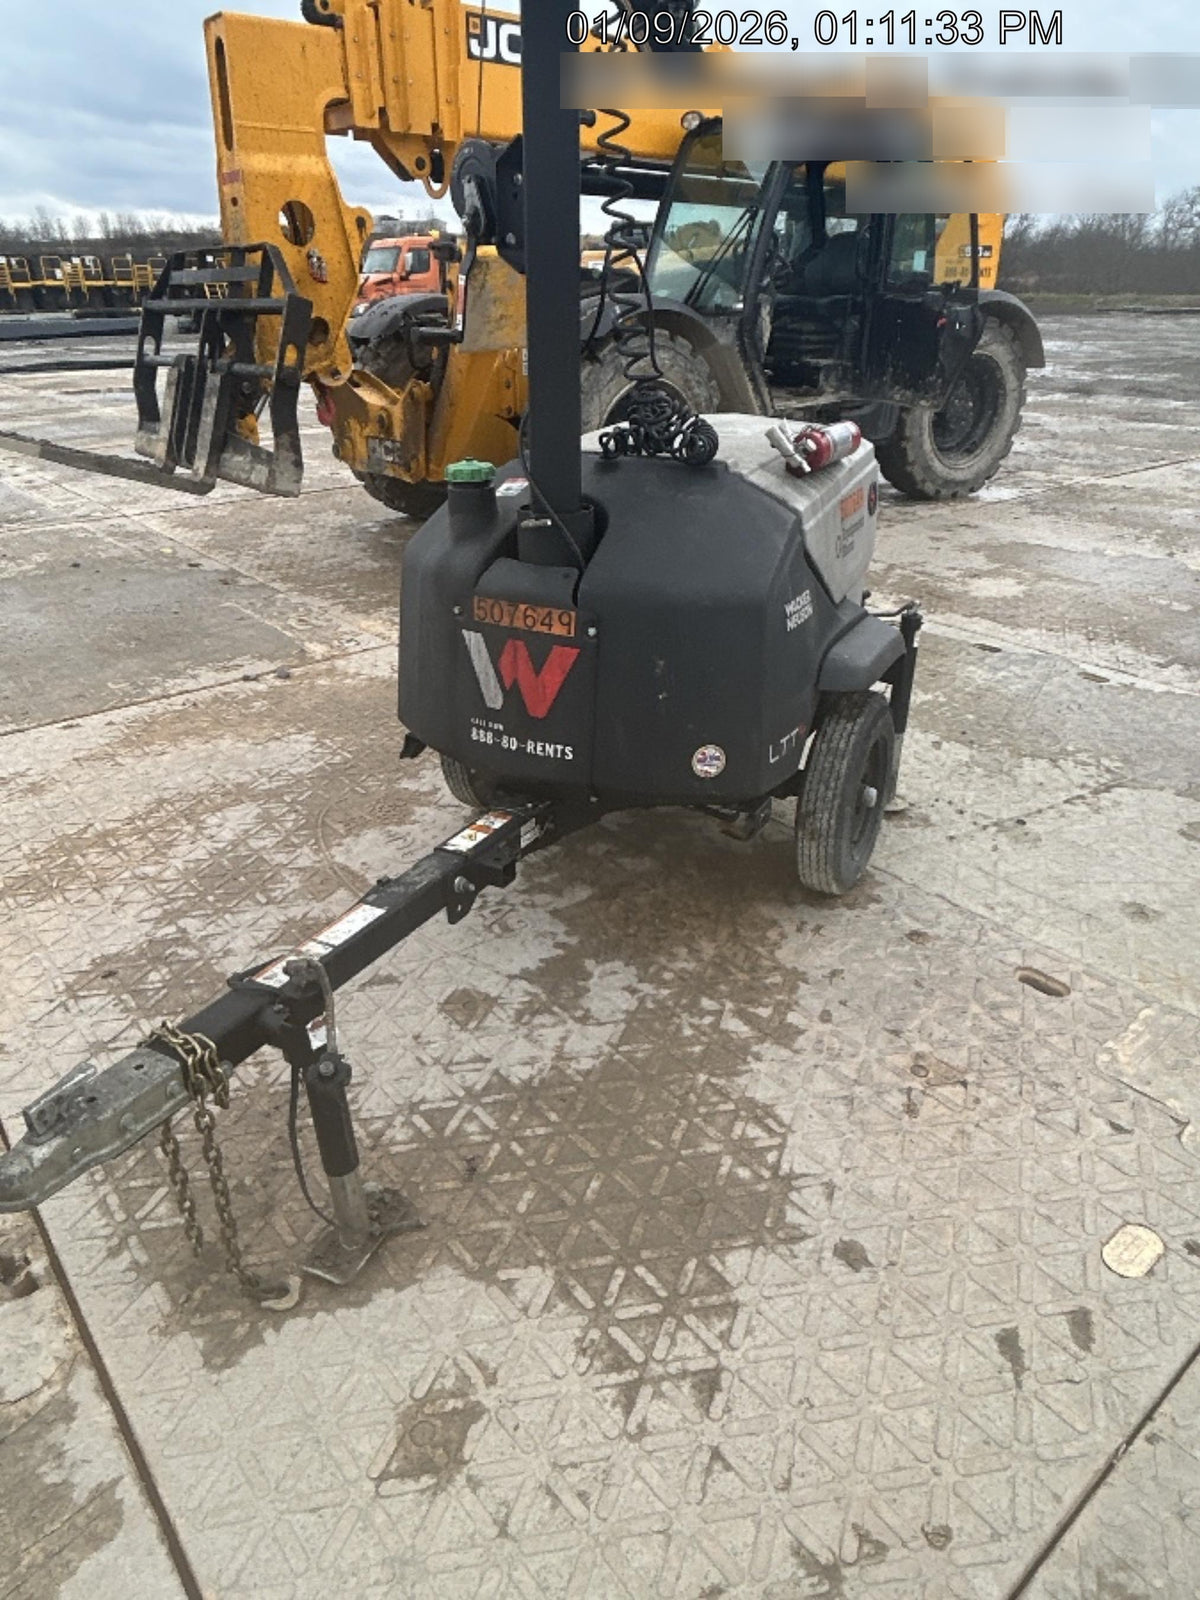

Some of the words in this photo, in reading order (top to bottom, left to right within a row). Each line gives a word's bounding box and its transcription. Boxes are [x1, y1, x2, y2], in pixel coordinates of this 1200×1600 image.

[469, 19, 522, 64] JC
[476, 598, 572, 635] 507649
[471, 727, 574, 760] 888-80-RENTS
